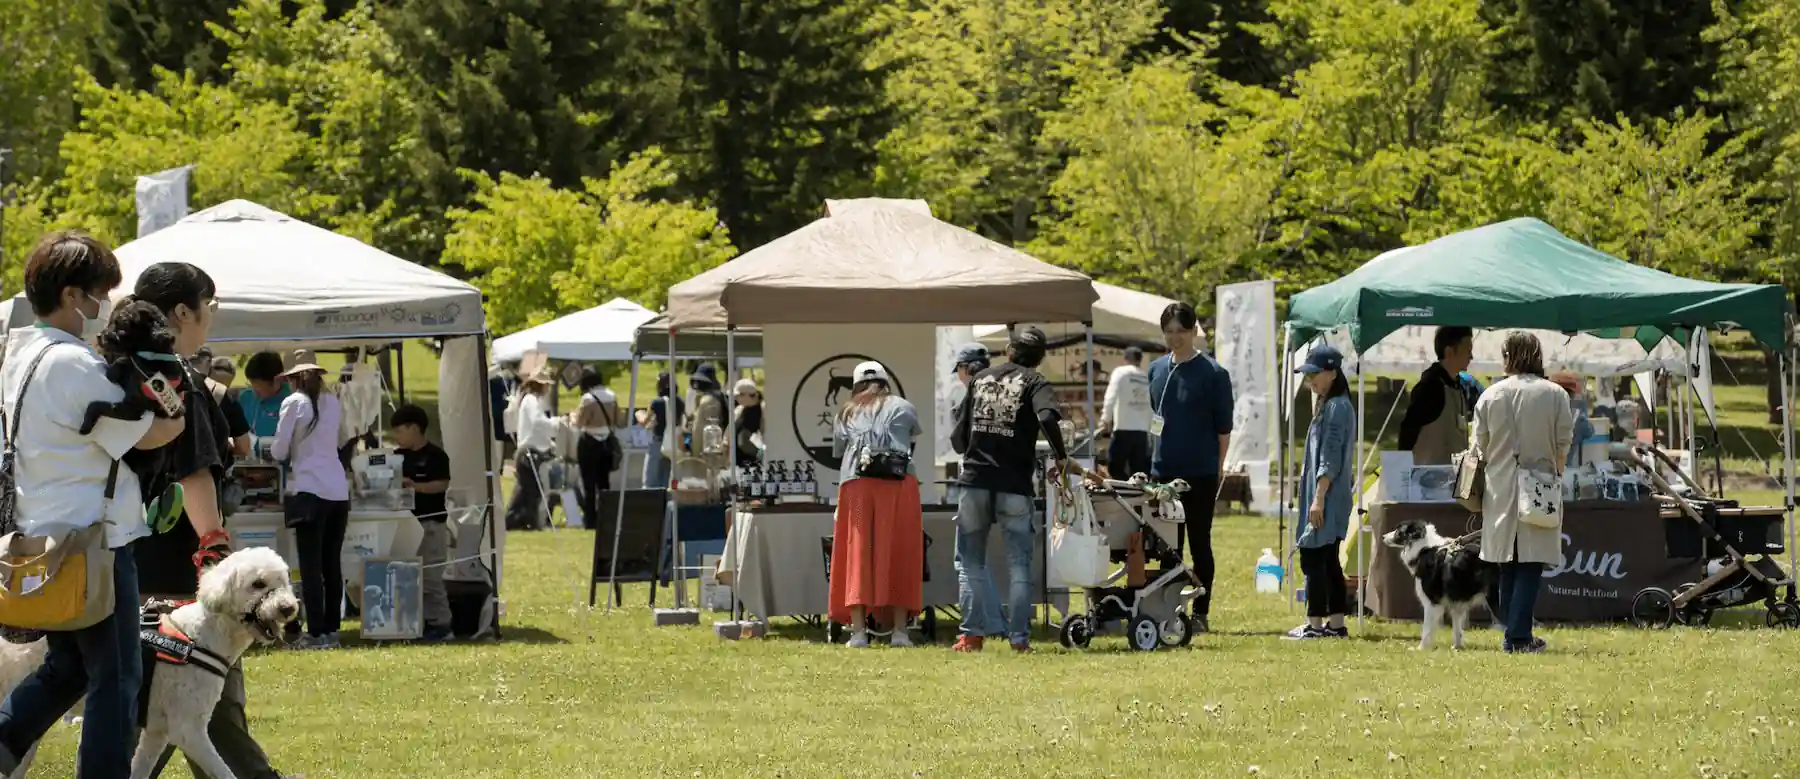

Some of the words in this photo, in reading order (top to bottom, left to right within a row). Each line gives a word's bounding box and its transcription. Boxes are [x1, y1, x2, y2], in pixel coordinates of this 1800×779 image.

[817, 411, 832, 426] 犬
[1541, 533, 1628, 579] Sun
[1548, 584, 1580, 597] Natural
[1583, 587, 1618, 598] Petfood
